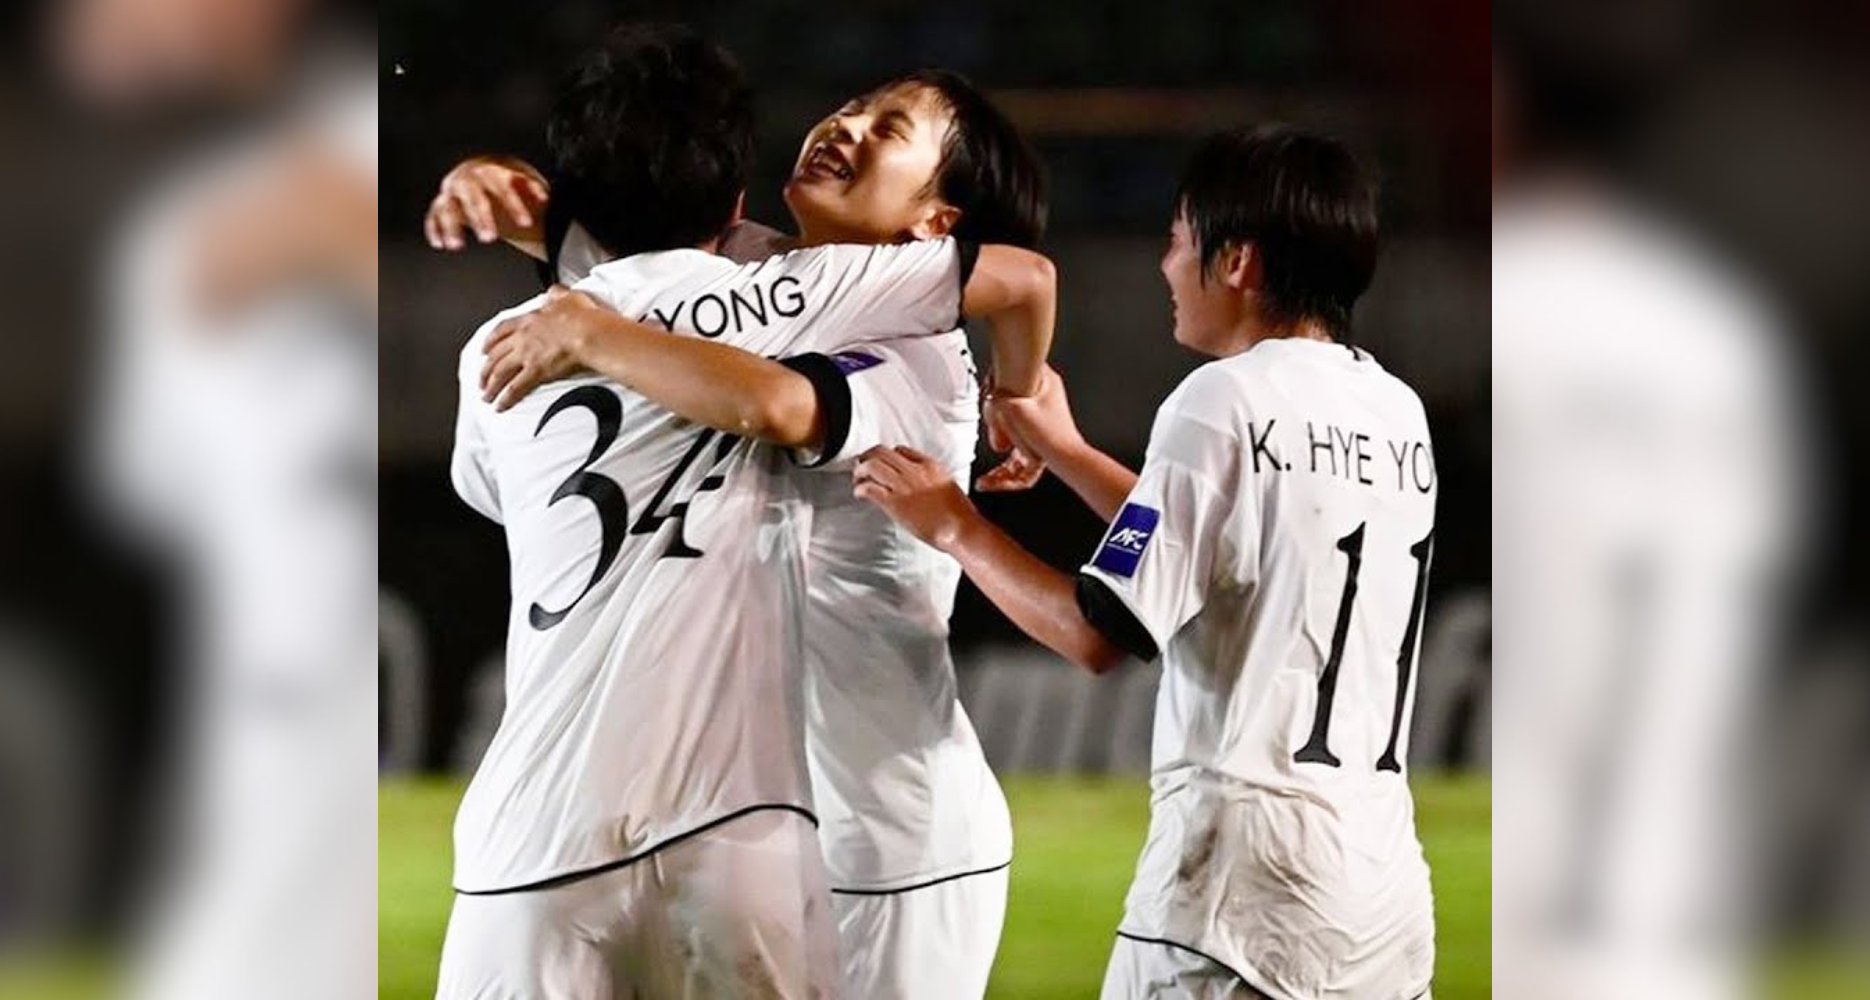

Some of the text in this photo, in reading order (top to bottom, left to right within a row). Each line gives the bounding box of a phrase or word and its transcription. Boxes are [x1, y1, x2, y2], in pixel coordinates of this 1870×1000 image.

[637, 276, 806, 338] YONG
[1248, 419, 1292, 473] K.
[1307, 421, 1374, 486] HYE
[1108, 527, 1150, 551] AFC
[1293, 521, 1435, 774] 11
